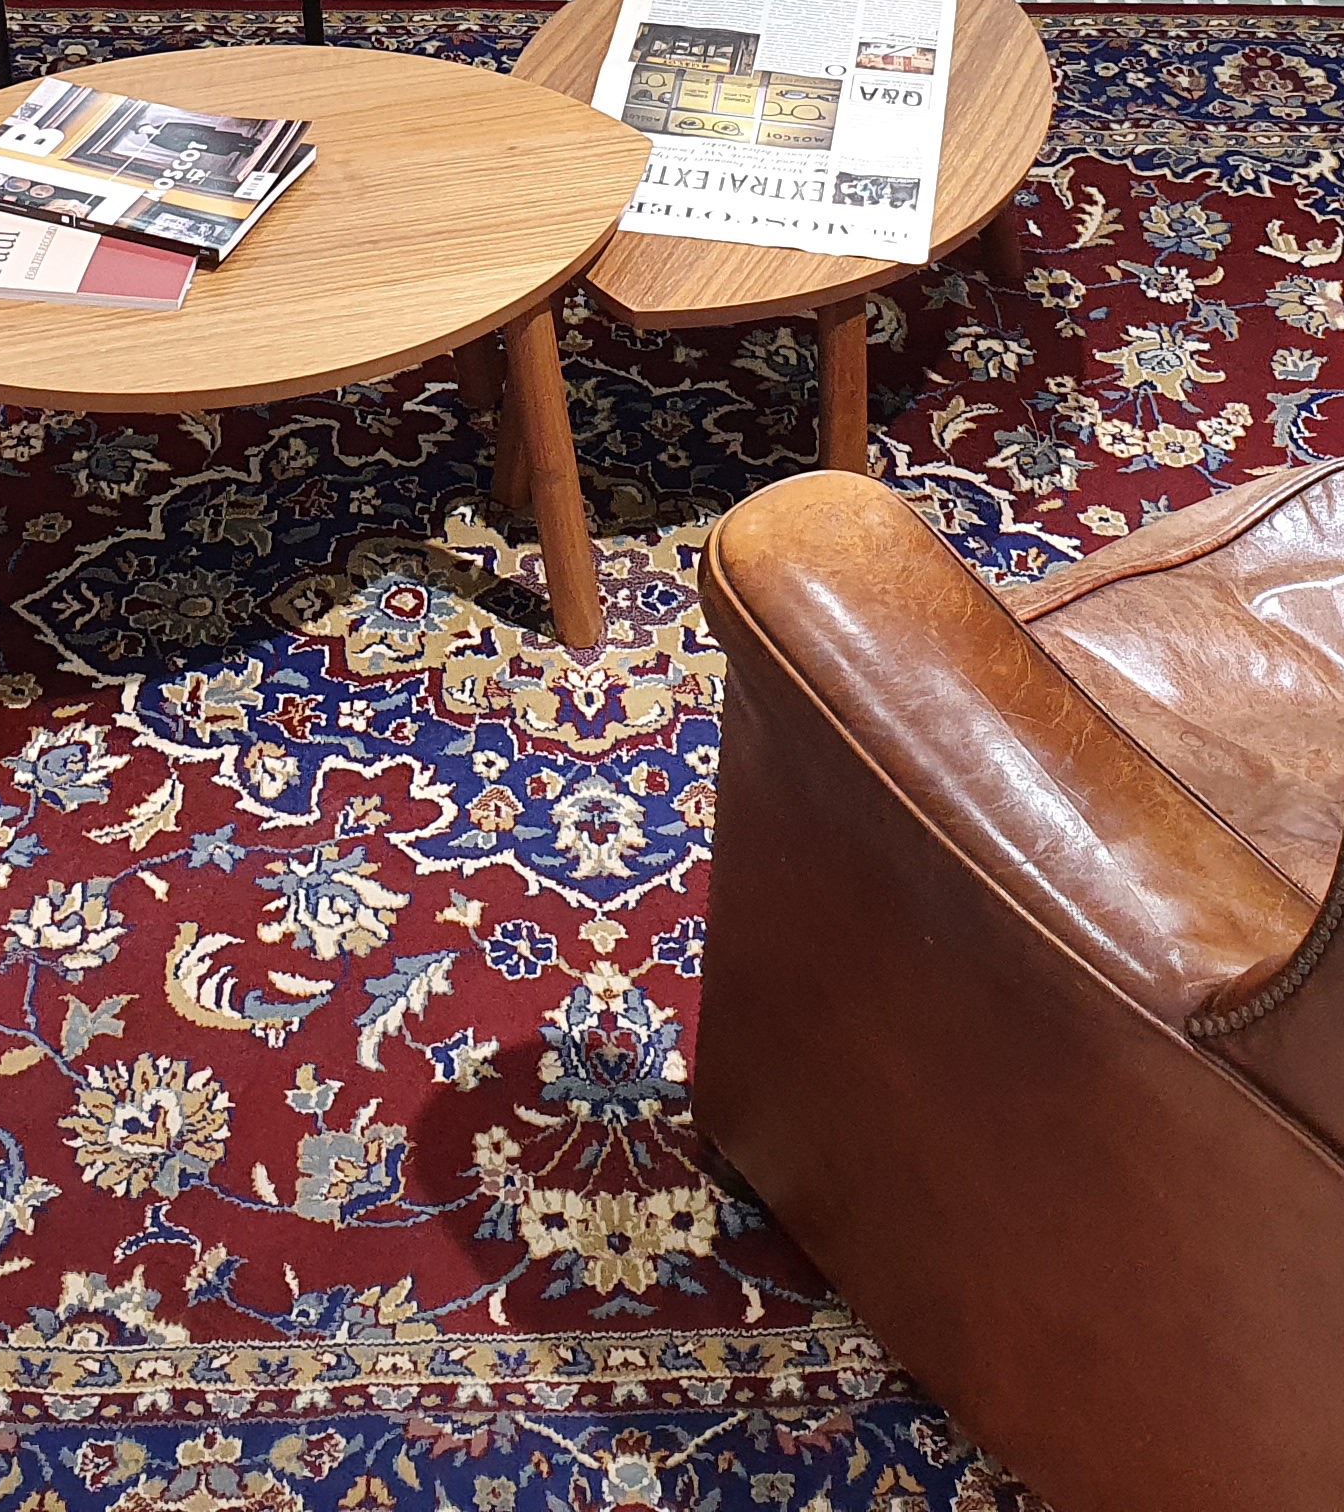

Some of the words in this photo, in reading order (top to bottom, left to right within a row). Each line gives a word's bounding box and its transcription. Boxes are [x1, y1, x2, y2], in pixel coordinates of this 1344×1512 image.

[765, 132, 825, 144] MOSCOT
[141, 140, 209, 203] MOSCOT
[719, 172, 826, 202] EXTRA!
